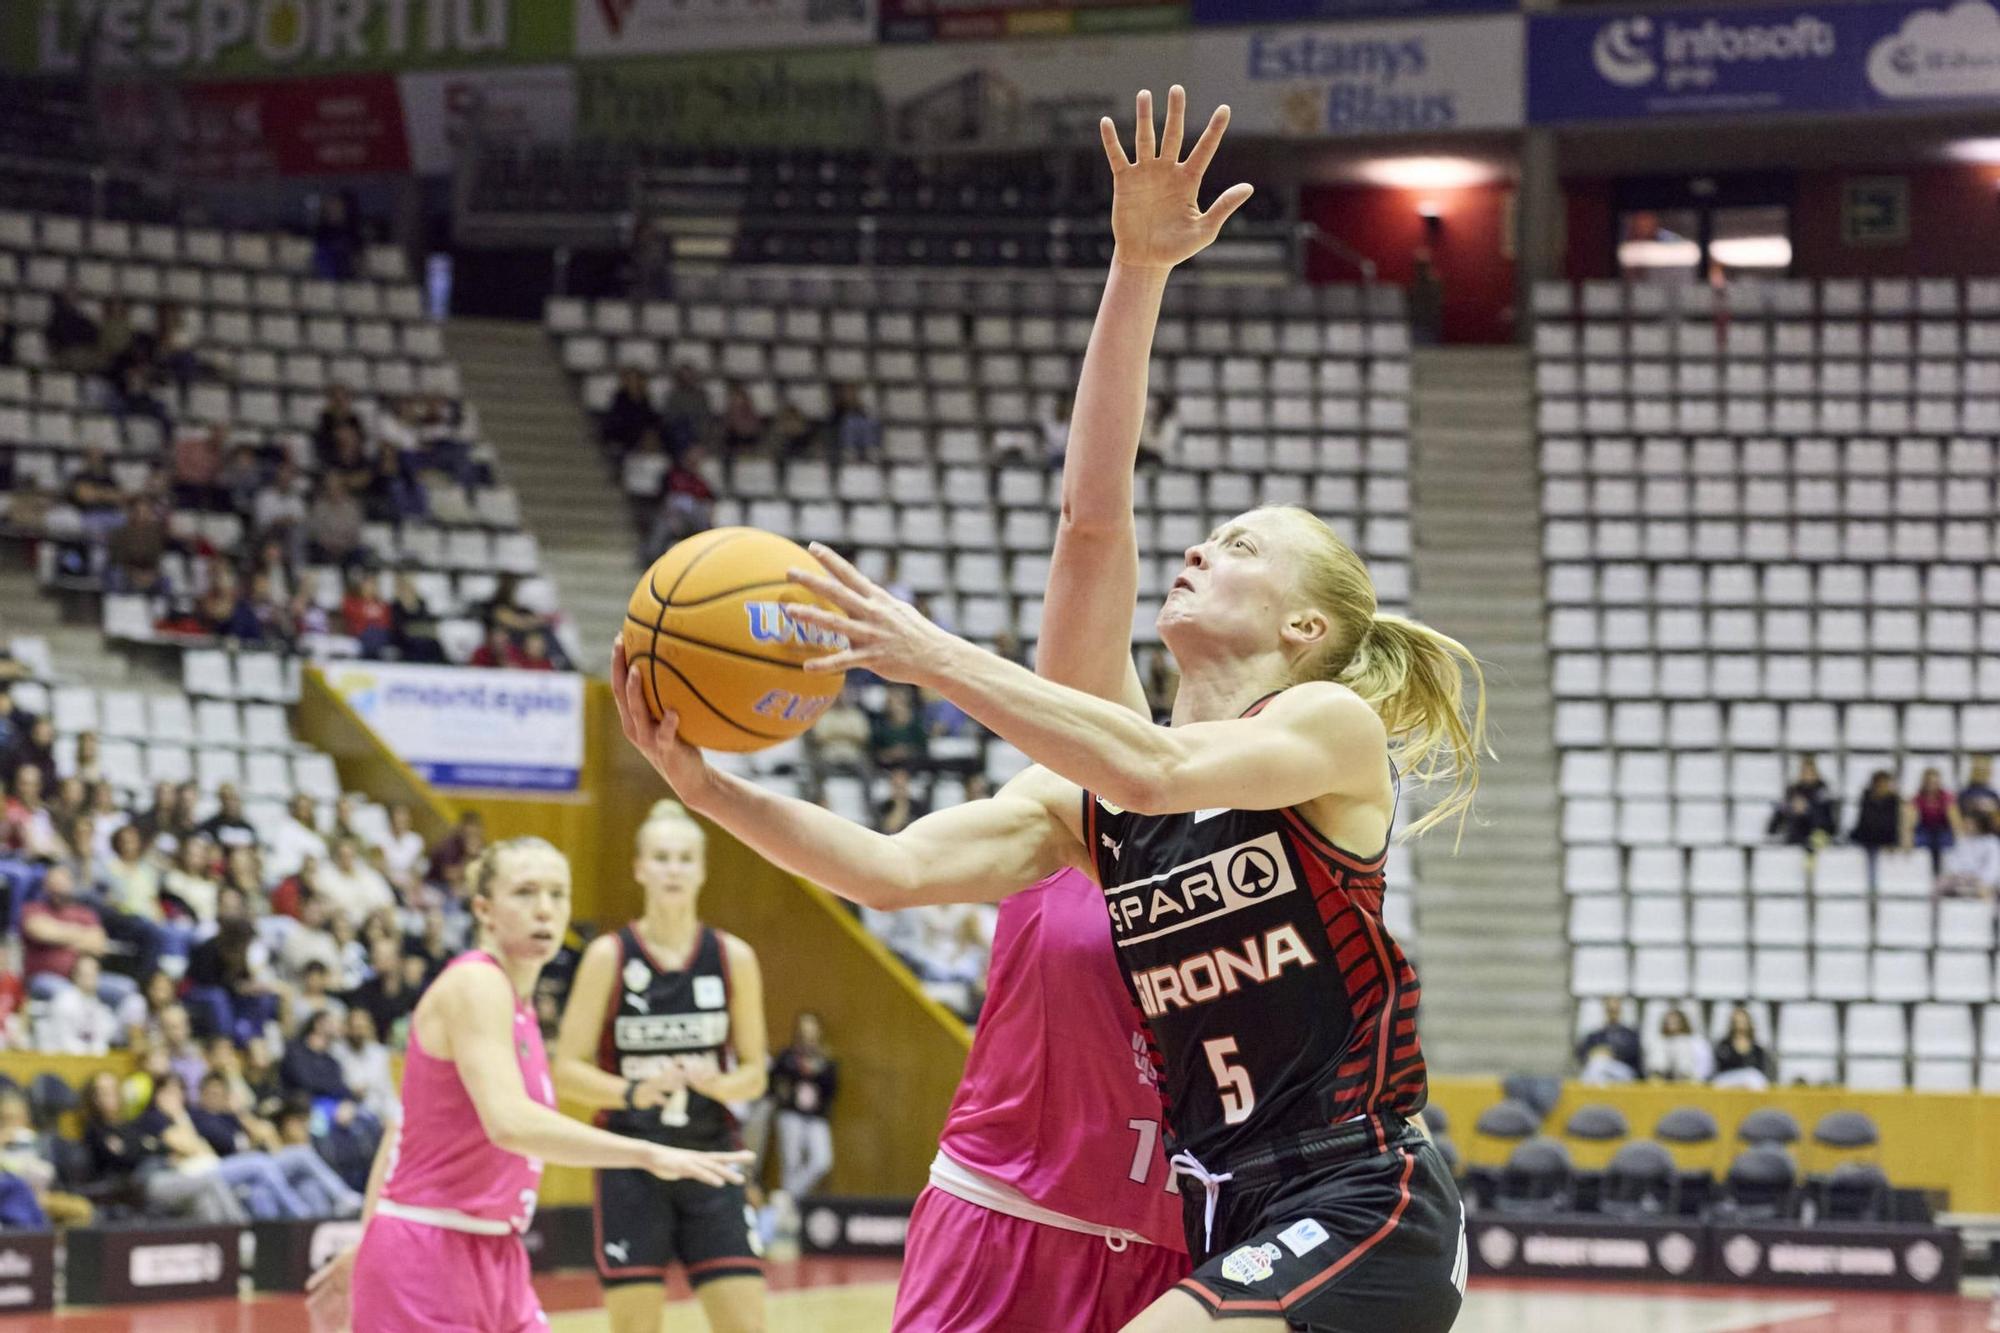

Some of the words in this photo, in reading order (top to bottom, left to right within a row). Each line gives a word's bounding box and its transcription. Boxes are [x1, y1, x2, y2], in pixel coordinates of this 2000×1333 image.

[1248, 31, 1427, 84] Estanys
[1663, 15, 1836, 60] infosoft
[1328, 83, 1457, 133] Blaus
[1203, 1036, 1255, 1125] 5
